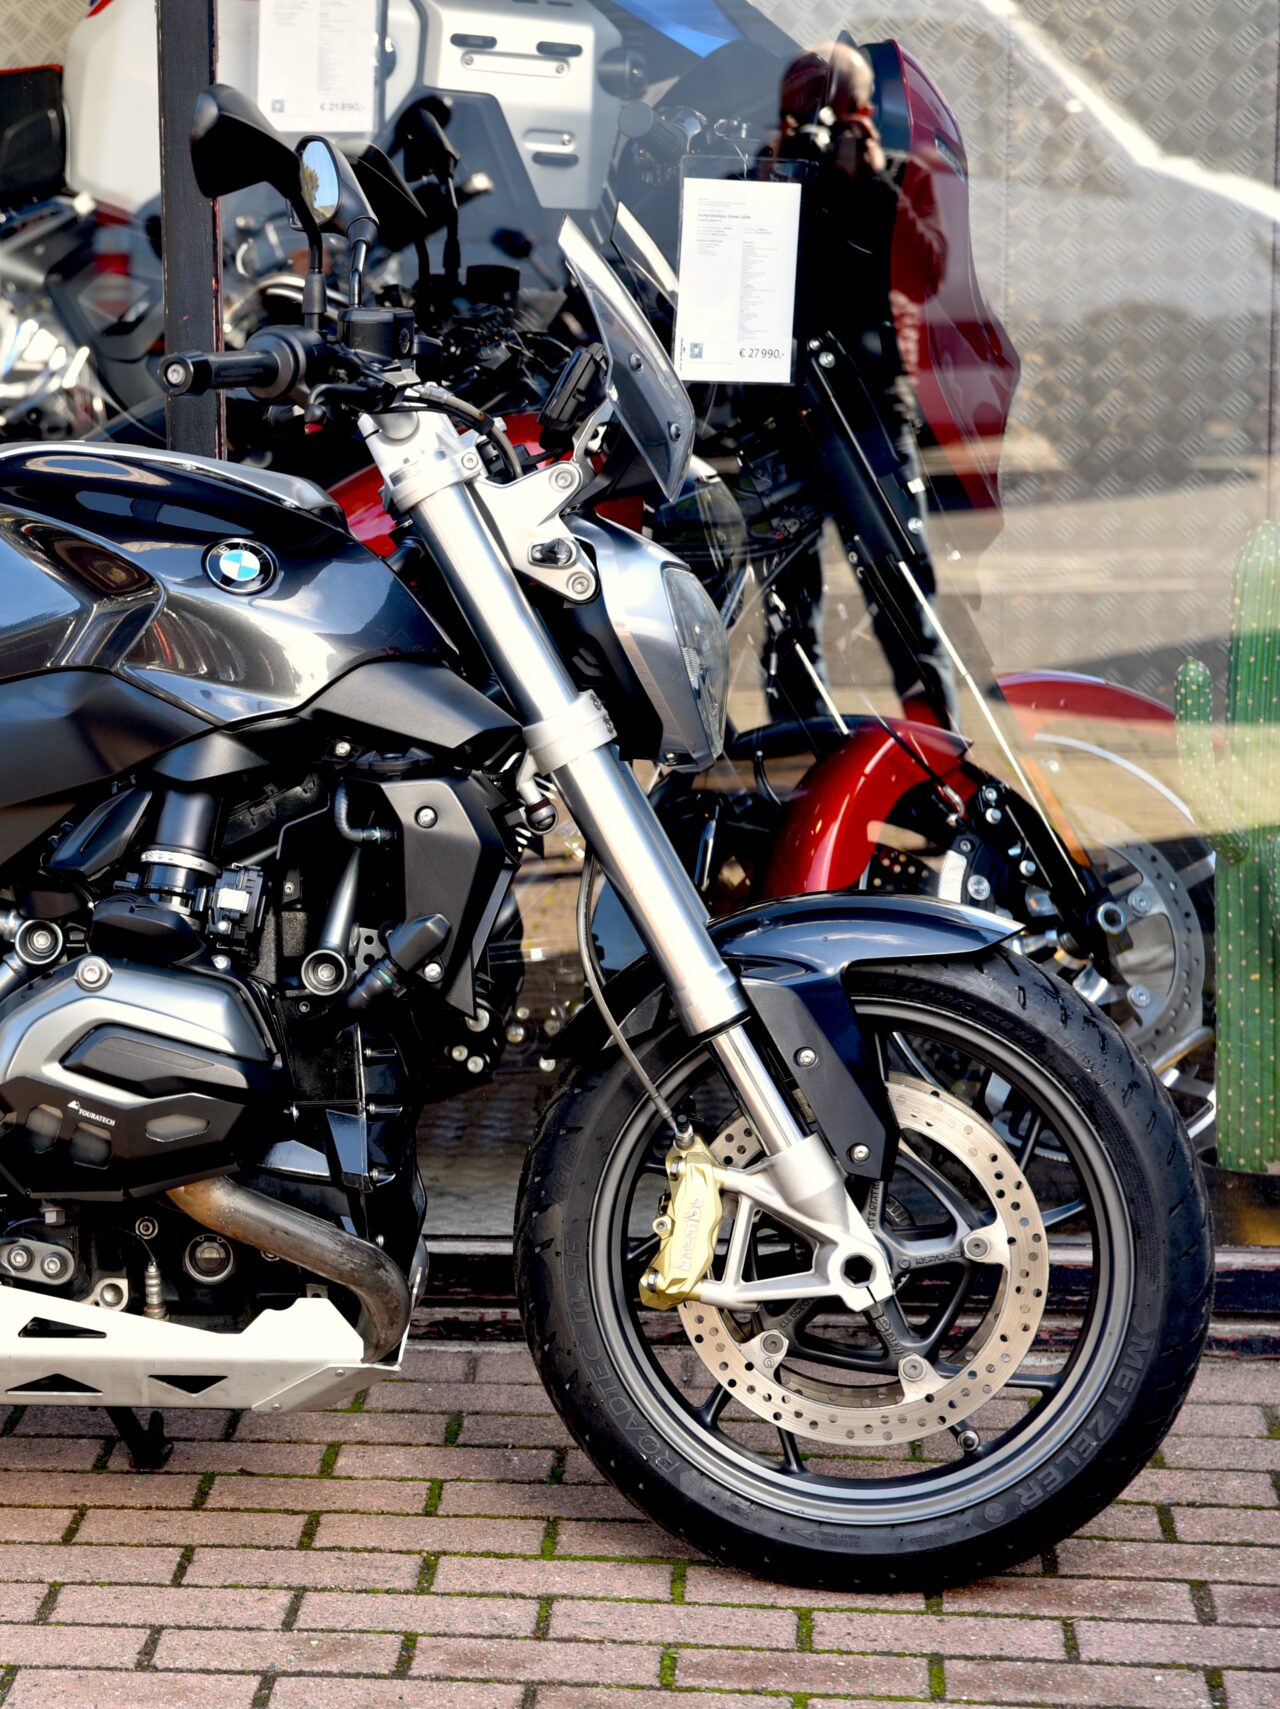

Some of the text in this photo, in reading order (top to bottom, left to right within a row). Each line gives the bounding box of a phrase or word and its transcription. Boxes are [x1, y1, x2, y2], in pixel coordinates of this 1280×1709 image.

[739, 347, 746, 358] €
[78, 1108, 116, 1127] TOURATECH
[582, 1342, 681, 1475] ROADTEC
[1013, 1336, 1154, 1508] METZELER
